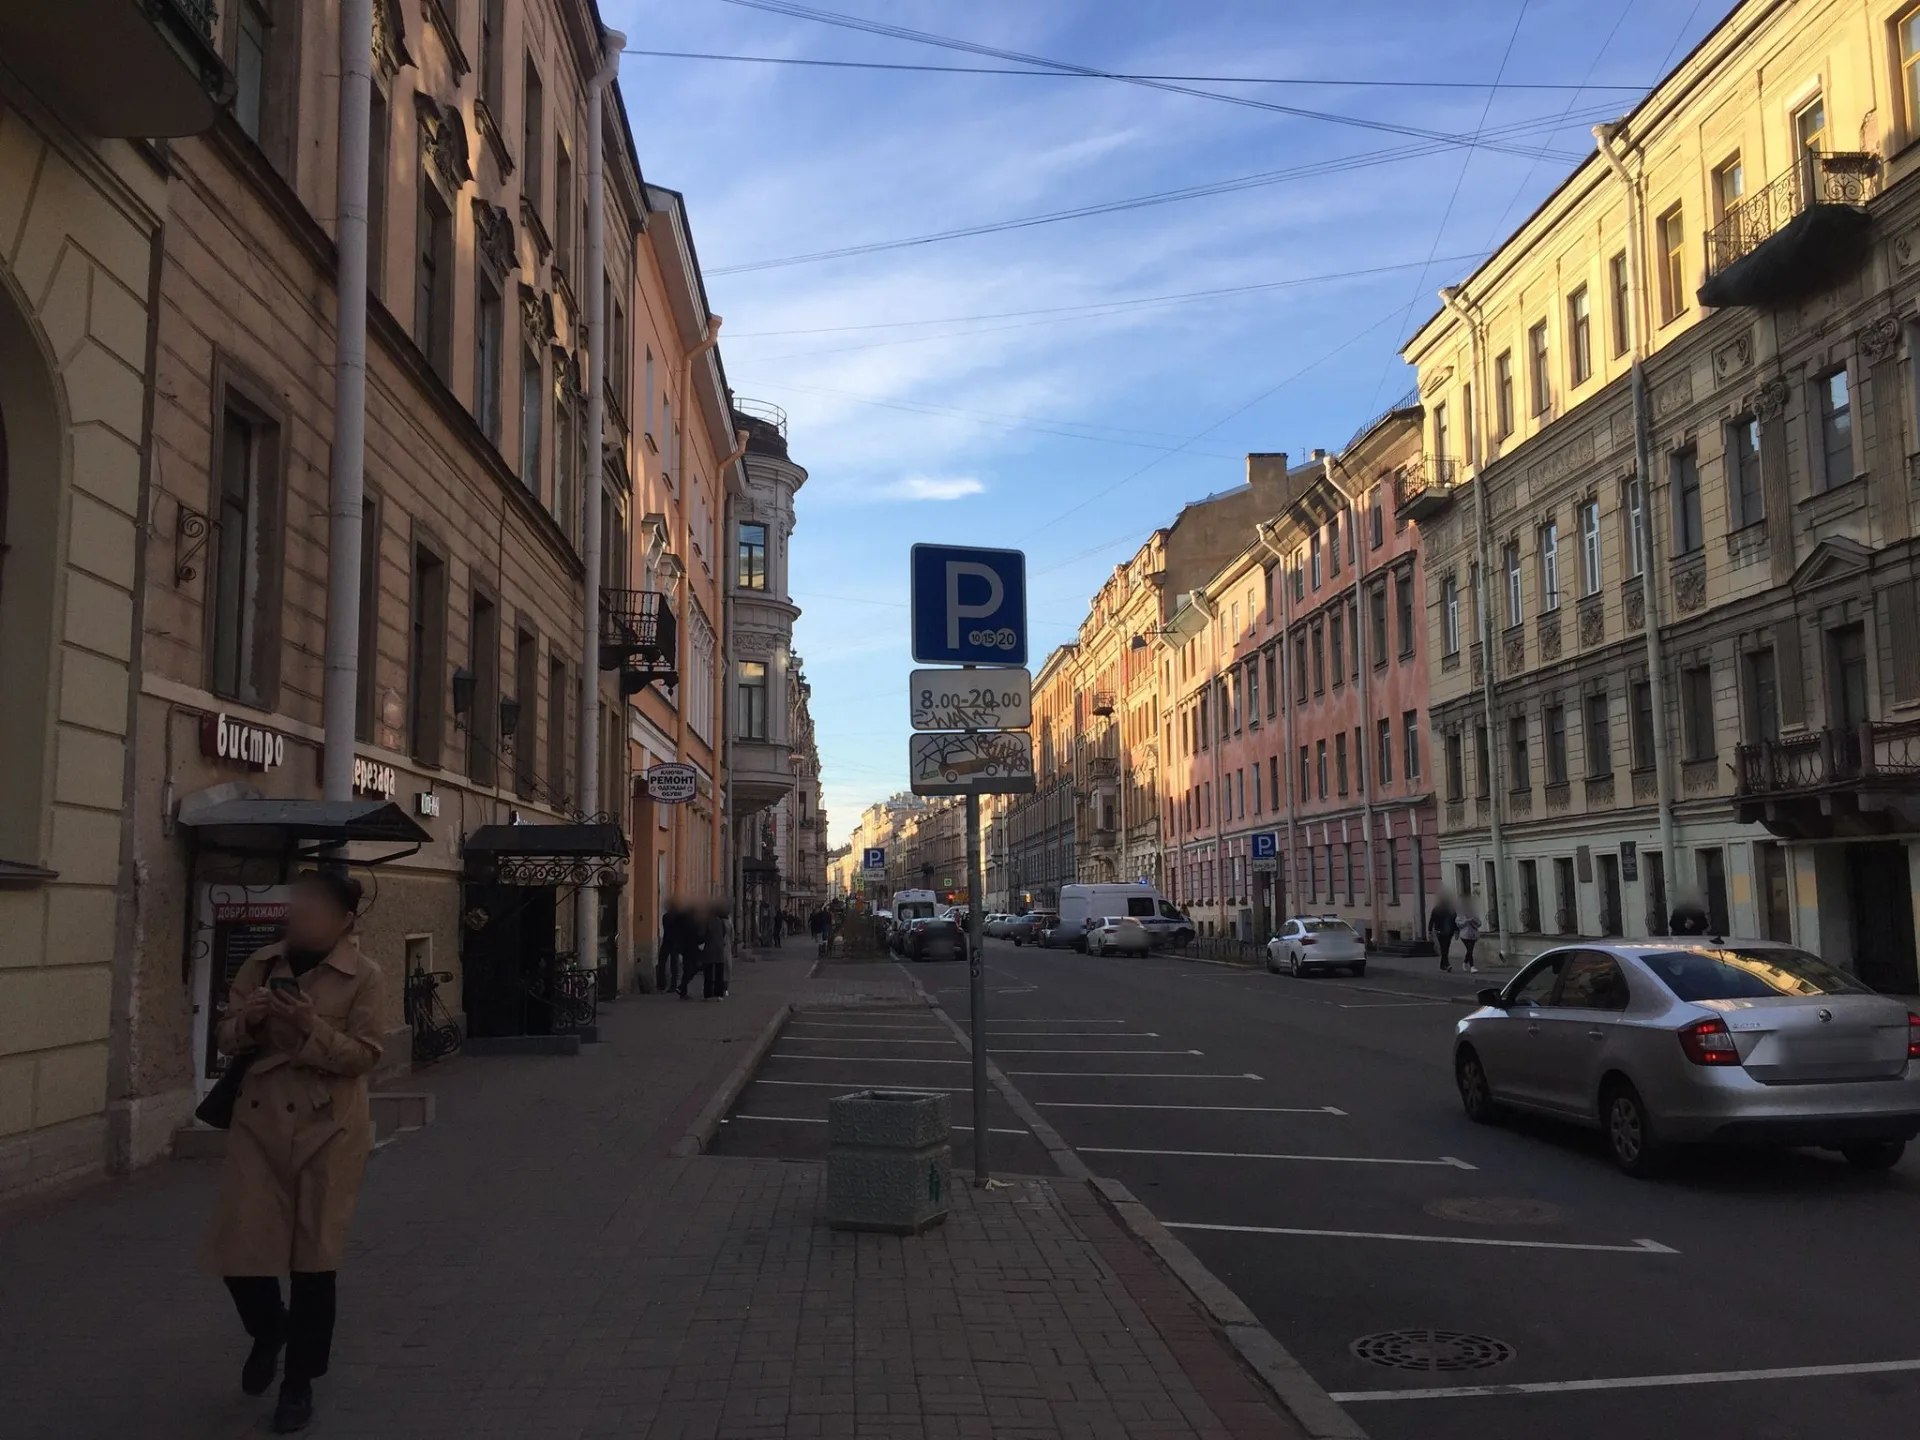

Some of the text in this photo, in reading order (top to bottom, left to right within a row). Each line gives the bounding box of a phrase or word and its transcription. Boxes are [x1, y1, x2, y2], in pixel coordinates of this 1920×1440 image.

[945, 560, 1004, 649] P
[971, 632, 1015, 645] 10 15 20
[217, 712, 284, 773] бистро
[352, 757, 396, 800] ерезада
[650, 776, 694, 784] РЕМОНТ
[1258, 836, 1272, 856] P
[869, 850, 881, 867] P
[217, 906, 246, 920] ДОБРО
